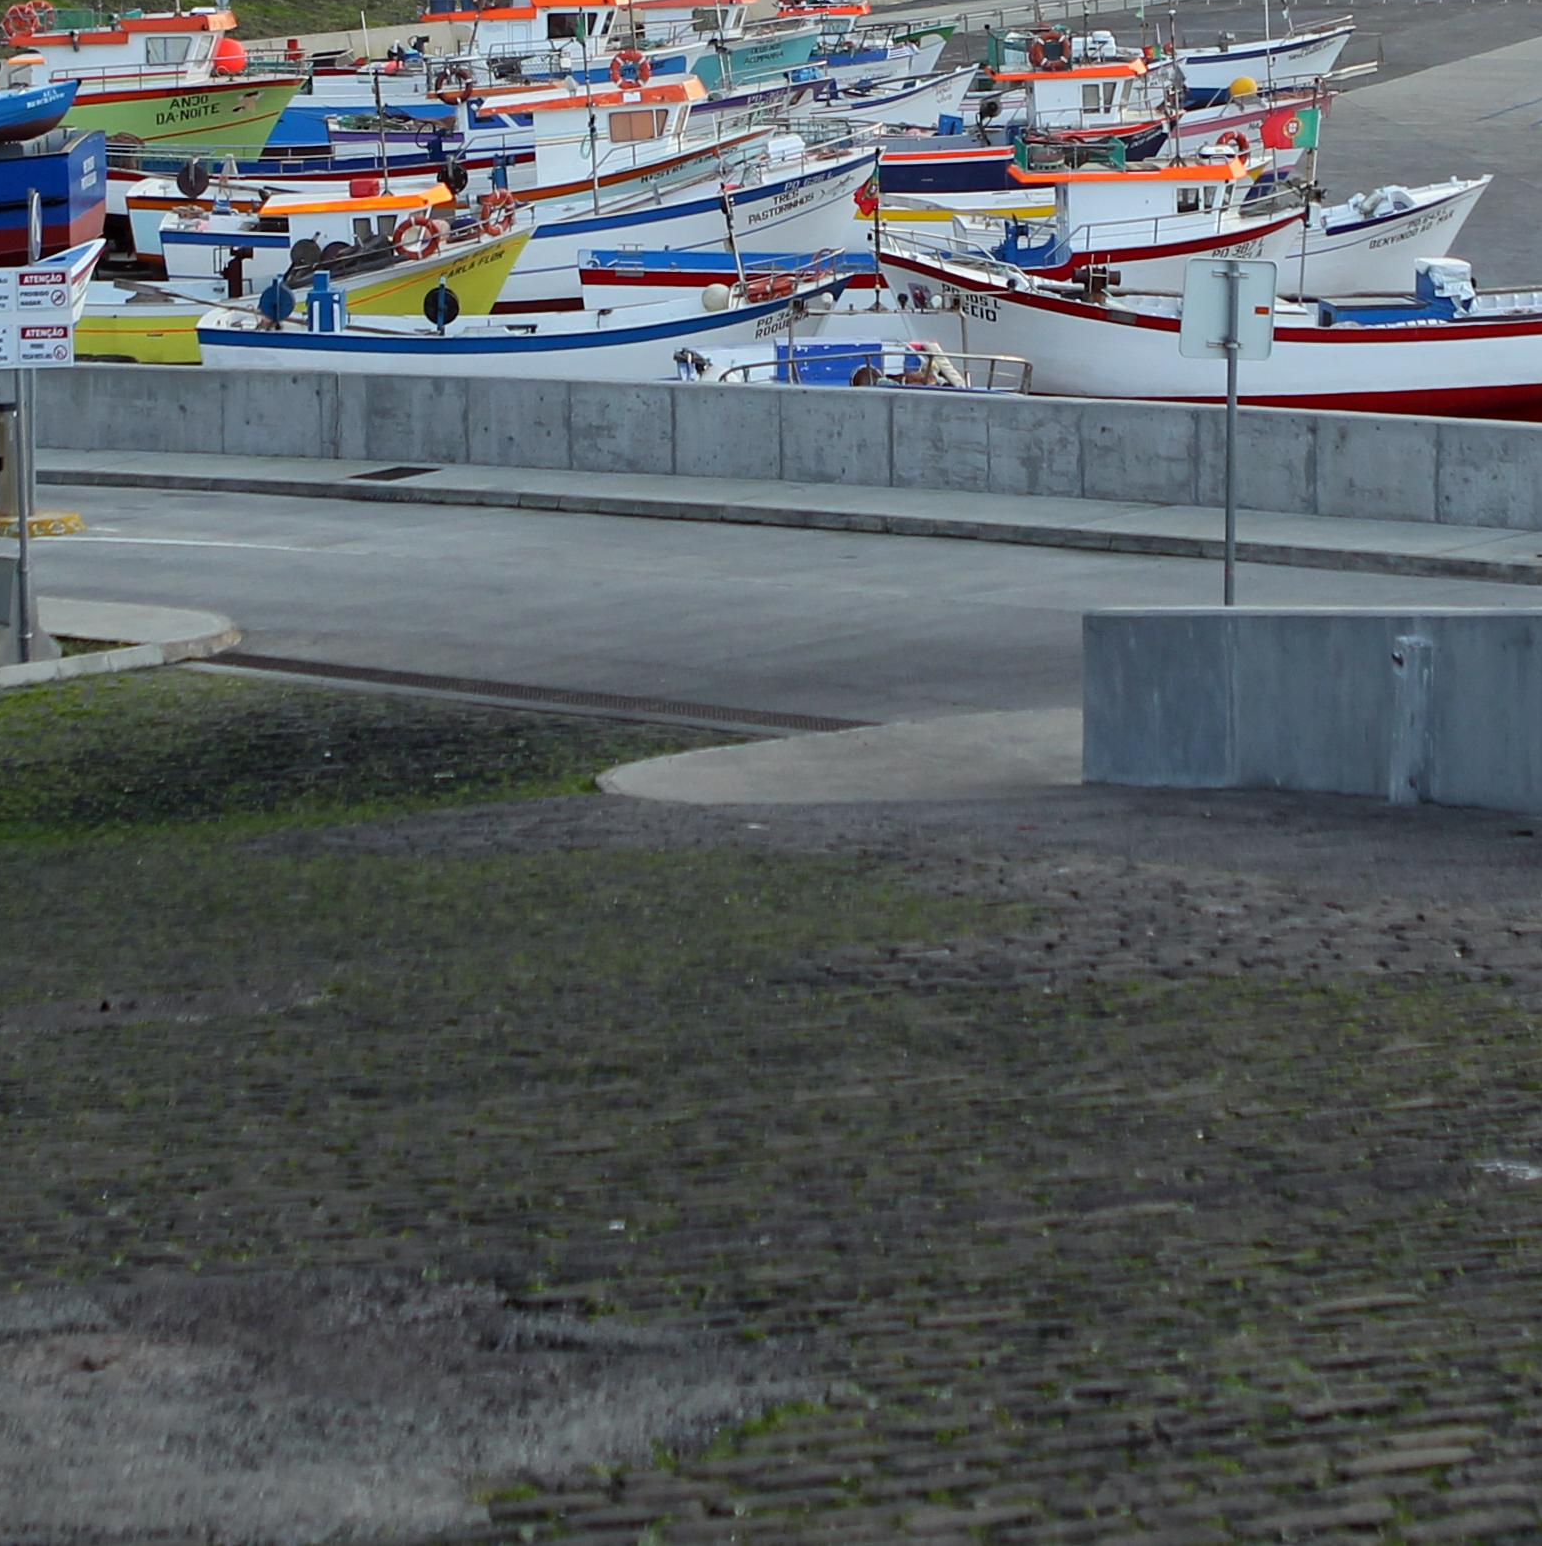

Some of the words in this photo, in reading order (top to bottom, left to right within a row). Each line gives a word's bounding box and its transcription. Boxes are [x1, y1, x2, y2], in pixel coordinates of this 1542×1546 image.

[169, 94, 209, 110] ANJO
[23, 274, 62, 285] ATENÇÃO
[757, 316, 773, 328] PD
[25, 328, 64, 339] ATENÇÃO
